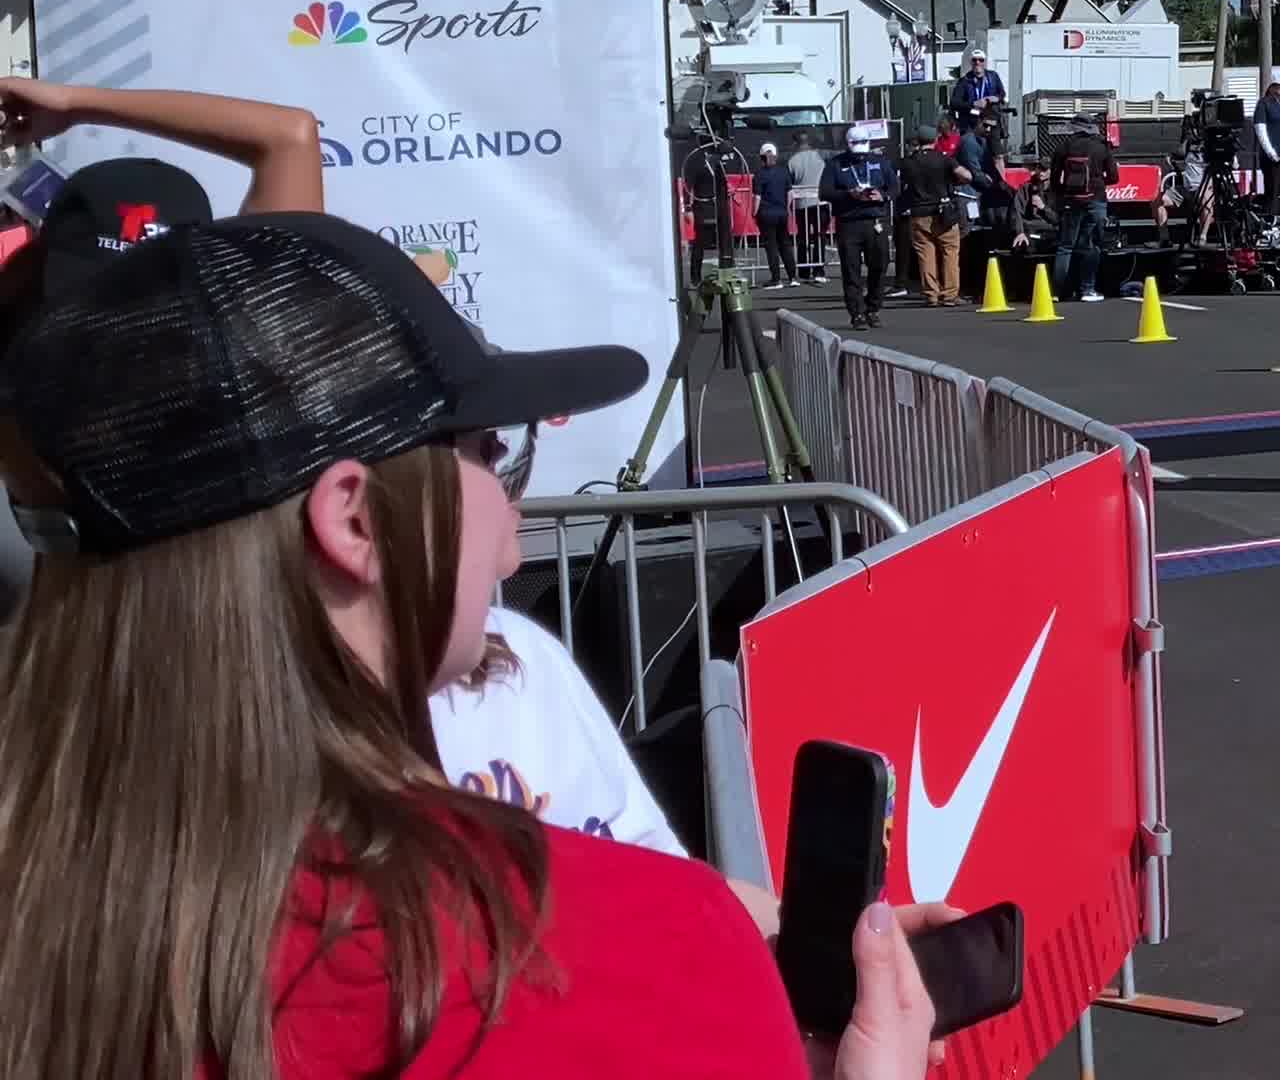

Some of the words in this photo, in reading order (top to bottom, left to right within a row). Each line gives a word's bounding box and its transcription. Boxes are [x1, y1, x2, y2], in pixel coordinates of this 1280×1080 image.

[361, 114, 417, 134] CITY
[427, 111, 463, 132] OF
[363, 128, 562, 165] ORLANDO
[378, 219, 480, 256] ORANGE
